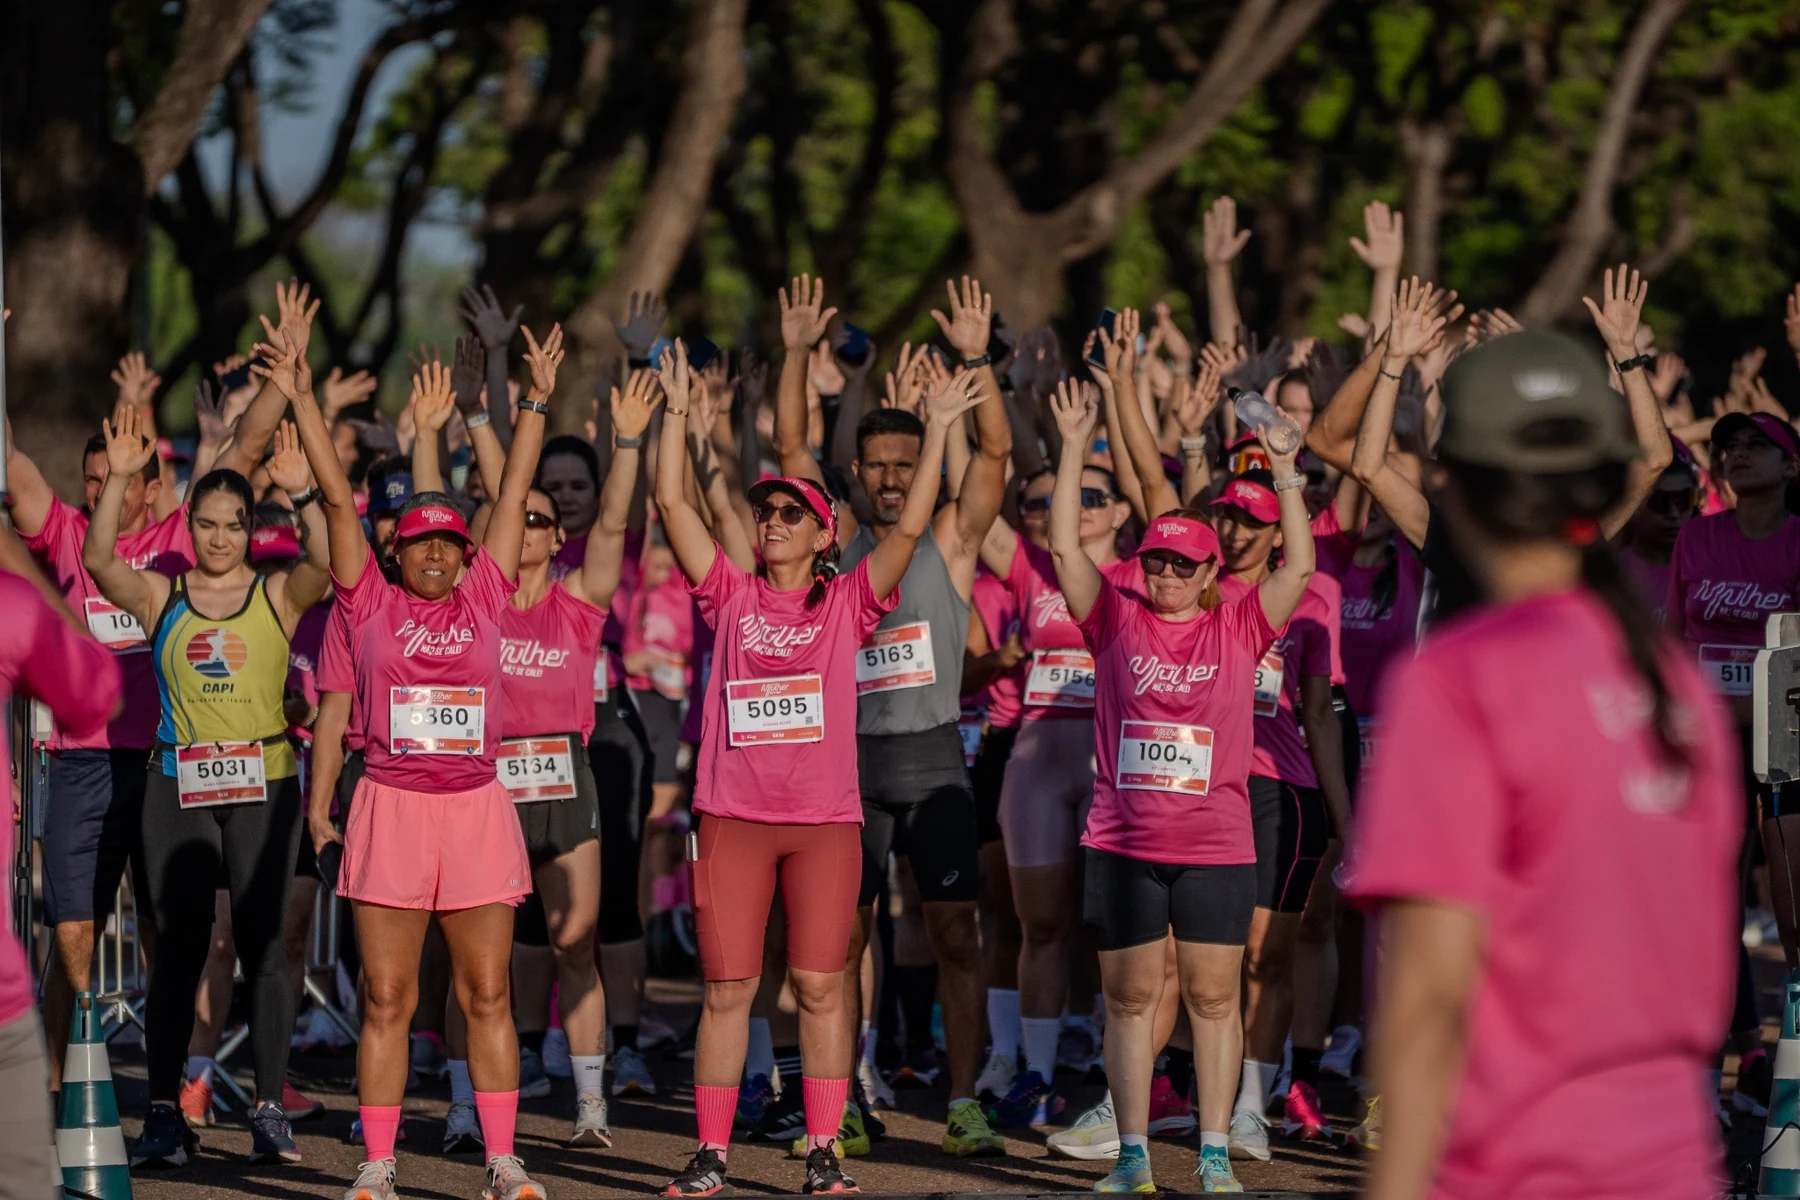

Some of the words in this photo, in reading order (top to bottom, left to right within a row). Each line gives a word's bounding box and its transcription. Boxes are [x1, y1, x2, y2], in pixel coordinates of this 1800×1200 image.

[865, 644, 914, 667] 5163
[1050, 668, 1095, 687] 5156
[1721, 664, 1751, 682] 511
[202, 683, 234, 694] CAPI
[410, 706, 468, 726] 5360
[748, 697, 807, 719] 5095
[1140, 742, 1193, 765] 1004
[197, 759, 246, 779] 5031
[508, 757, 556, 777] 5164
